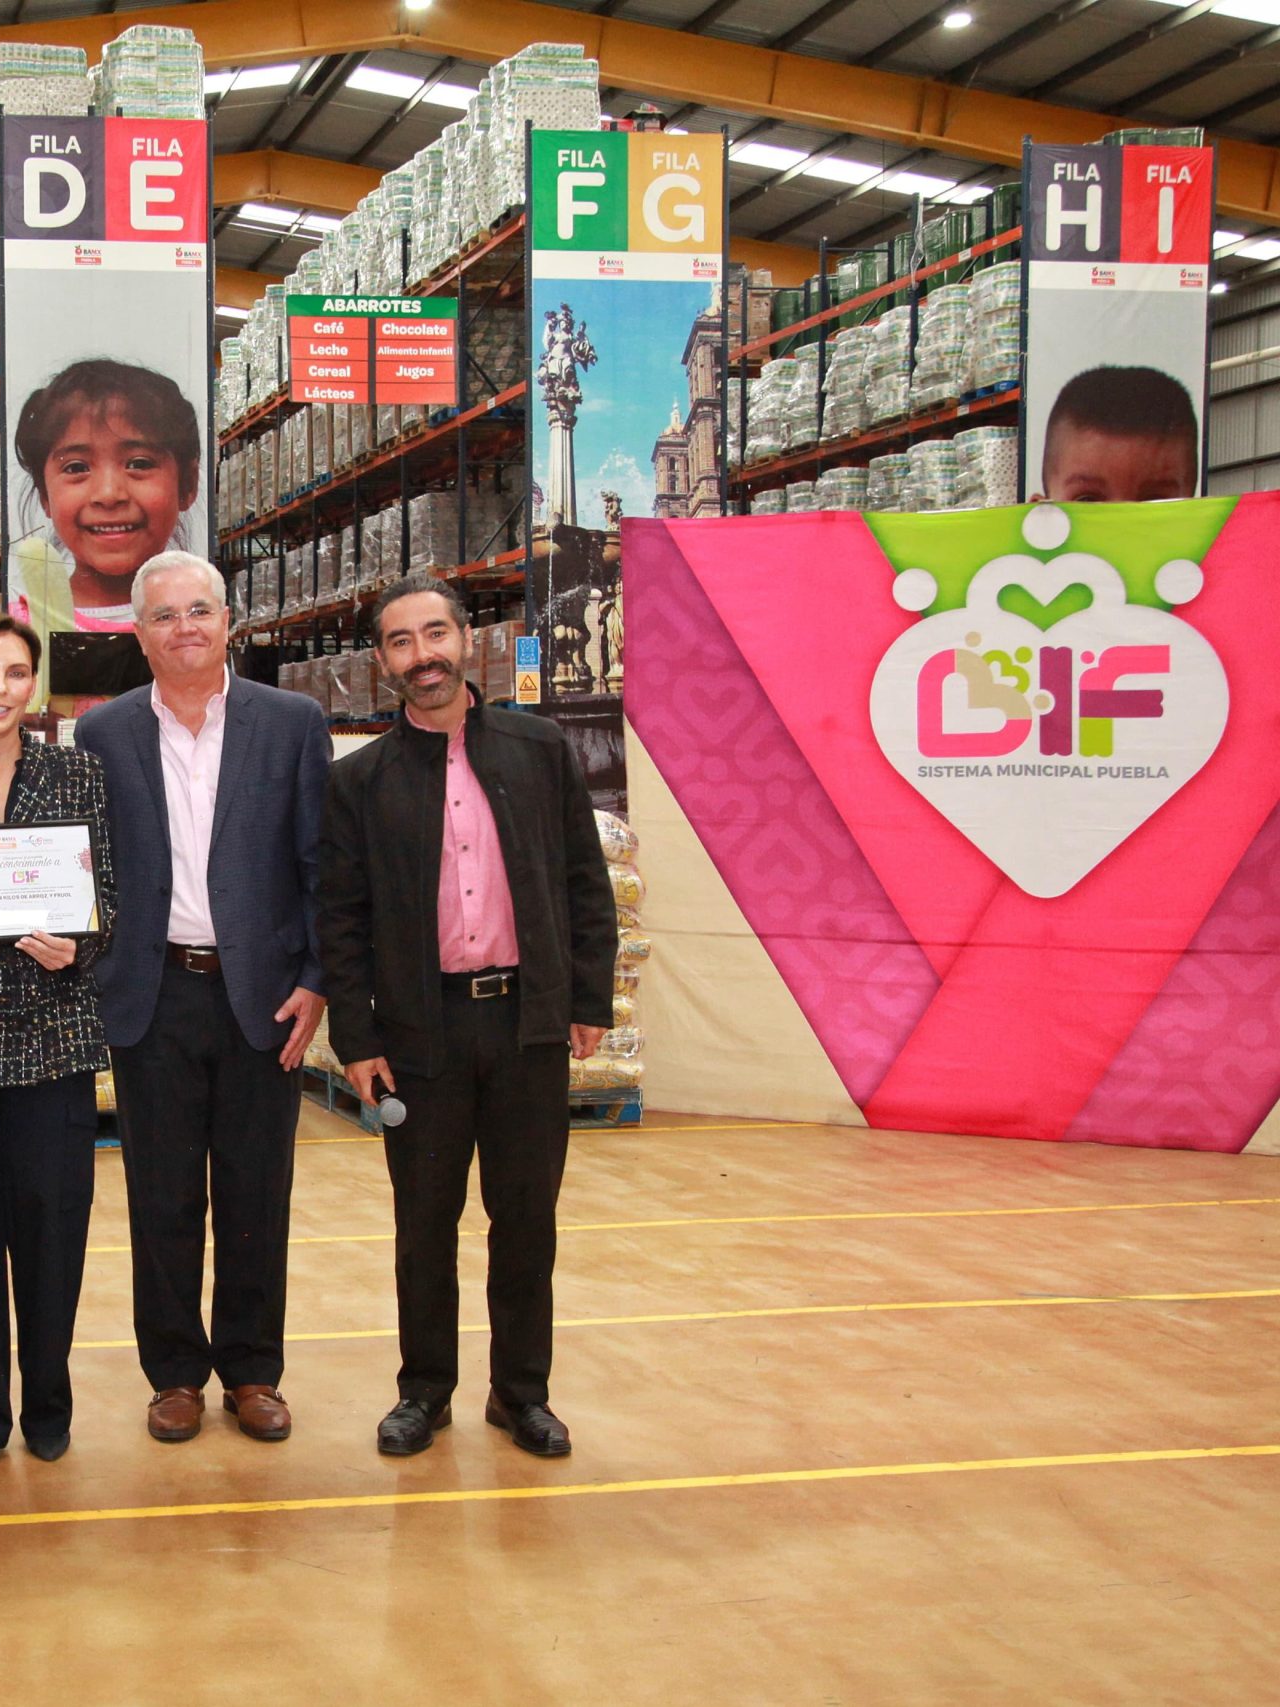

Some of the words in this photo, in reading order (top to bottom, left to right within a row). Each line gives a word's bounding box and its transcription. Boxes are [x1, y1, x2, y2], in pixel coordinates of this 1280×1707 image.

[30, 135, 82, 154] FILA
[132, 138, 184, 157] FILA
[557, 149, 606, 168] FILA
[652, 152, 701, 171] FILA
[1053, 163, 1101, 181] FILA
[1146, 165, 1193, 184] FILA
[23, 157, 86, 229] D
[129, 160, 184, 231] E
[557, 171, 606, 240] F
[642, 173, 705, 243] G
[1045, 183, 1102, 252] H
[1157, 186, 1174, 254] I
[322, 298, 422, 313] ABARROTES
[313, 321, 344, 334] Café
[381, 323, 448, 335] Chocolate
[309, 344, 348, 356] Leche
[377, 346, 418, 356] Alimento
[419, 346, 453, 356] Infantil
[308, 365, 351, 377] Cereal
[395, 365, 435, 380] Jugos
[304, 387, 355, 400] Lácteos
[917, 765, 993, 778] SISTEMA
[996, 764, 1093, 779] MUNICIPAL
[1097, 766, 1170, 779] PUEBLA
